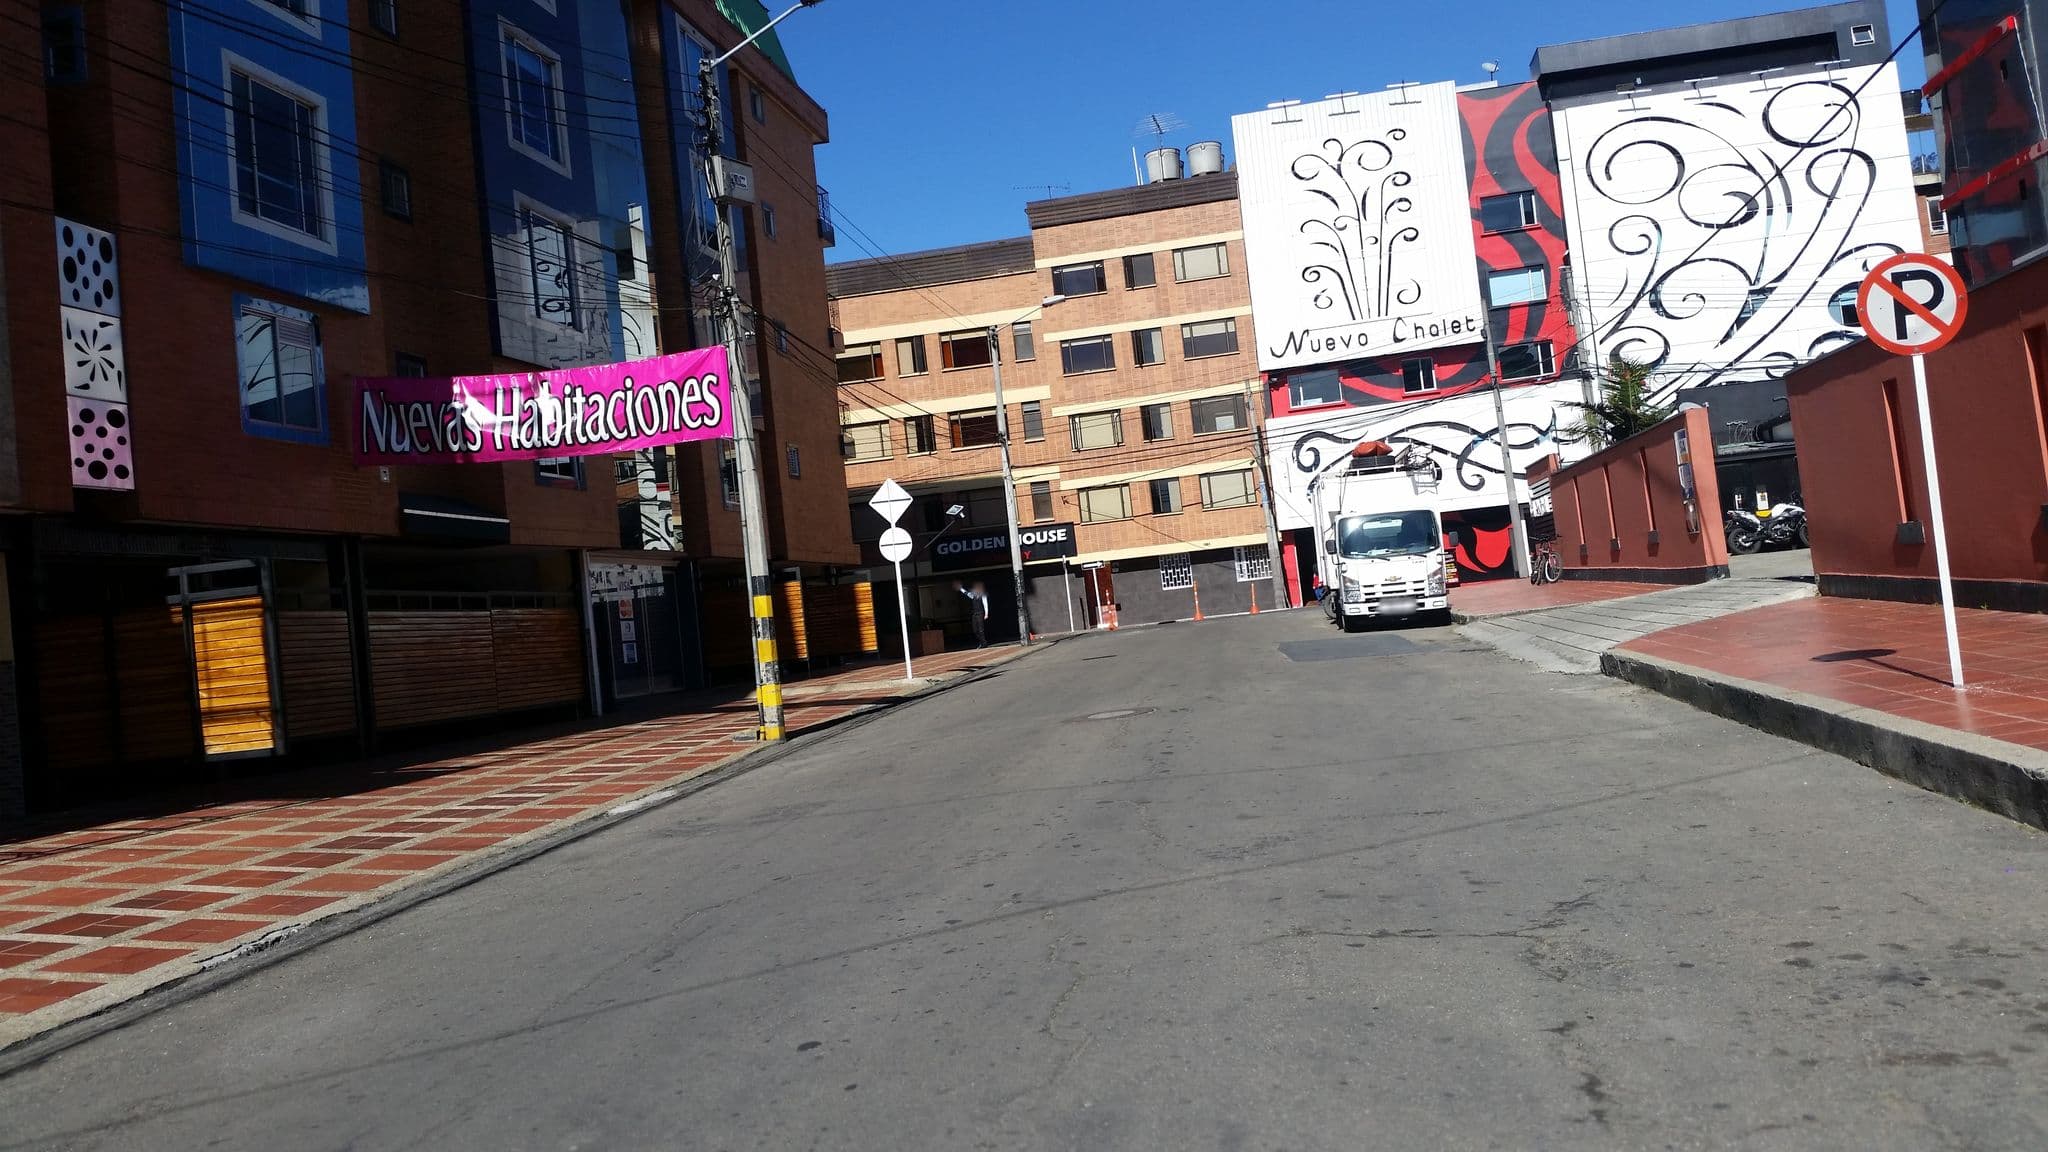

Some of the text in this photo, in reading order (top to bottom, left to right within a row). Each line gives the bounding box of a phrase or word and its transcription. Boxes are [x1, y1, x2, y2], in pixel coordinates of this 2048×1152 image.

[1891, 270, 1944, 340] P
[1270, 316, 1476, 358] Nuevo Chalet
[360, 374, 722, 455] Nuevas Habitaciones
[938, 536, 1005, 555] GOLDEN
